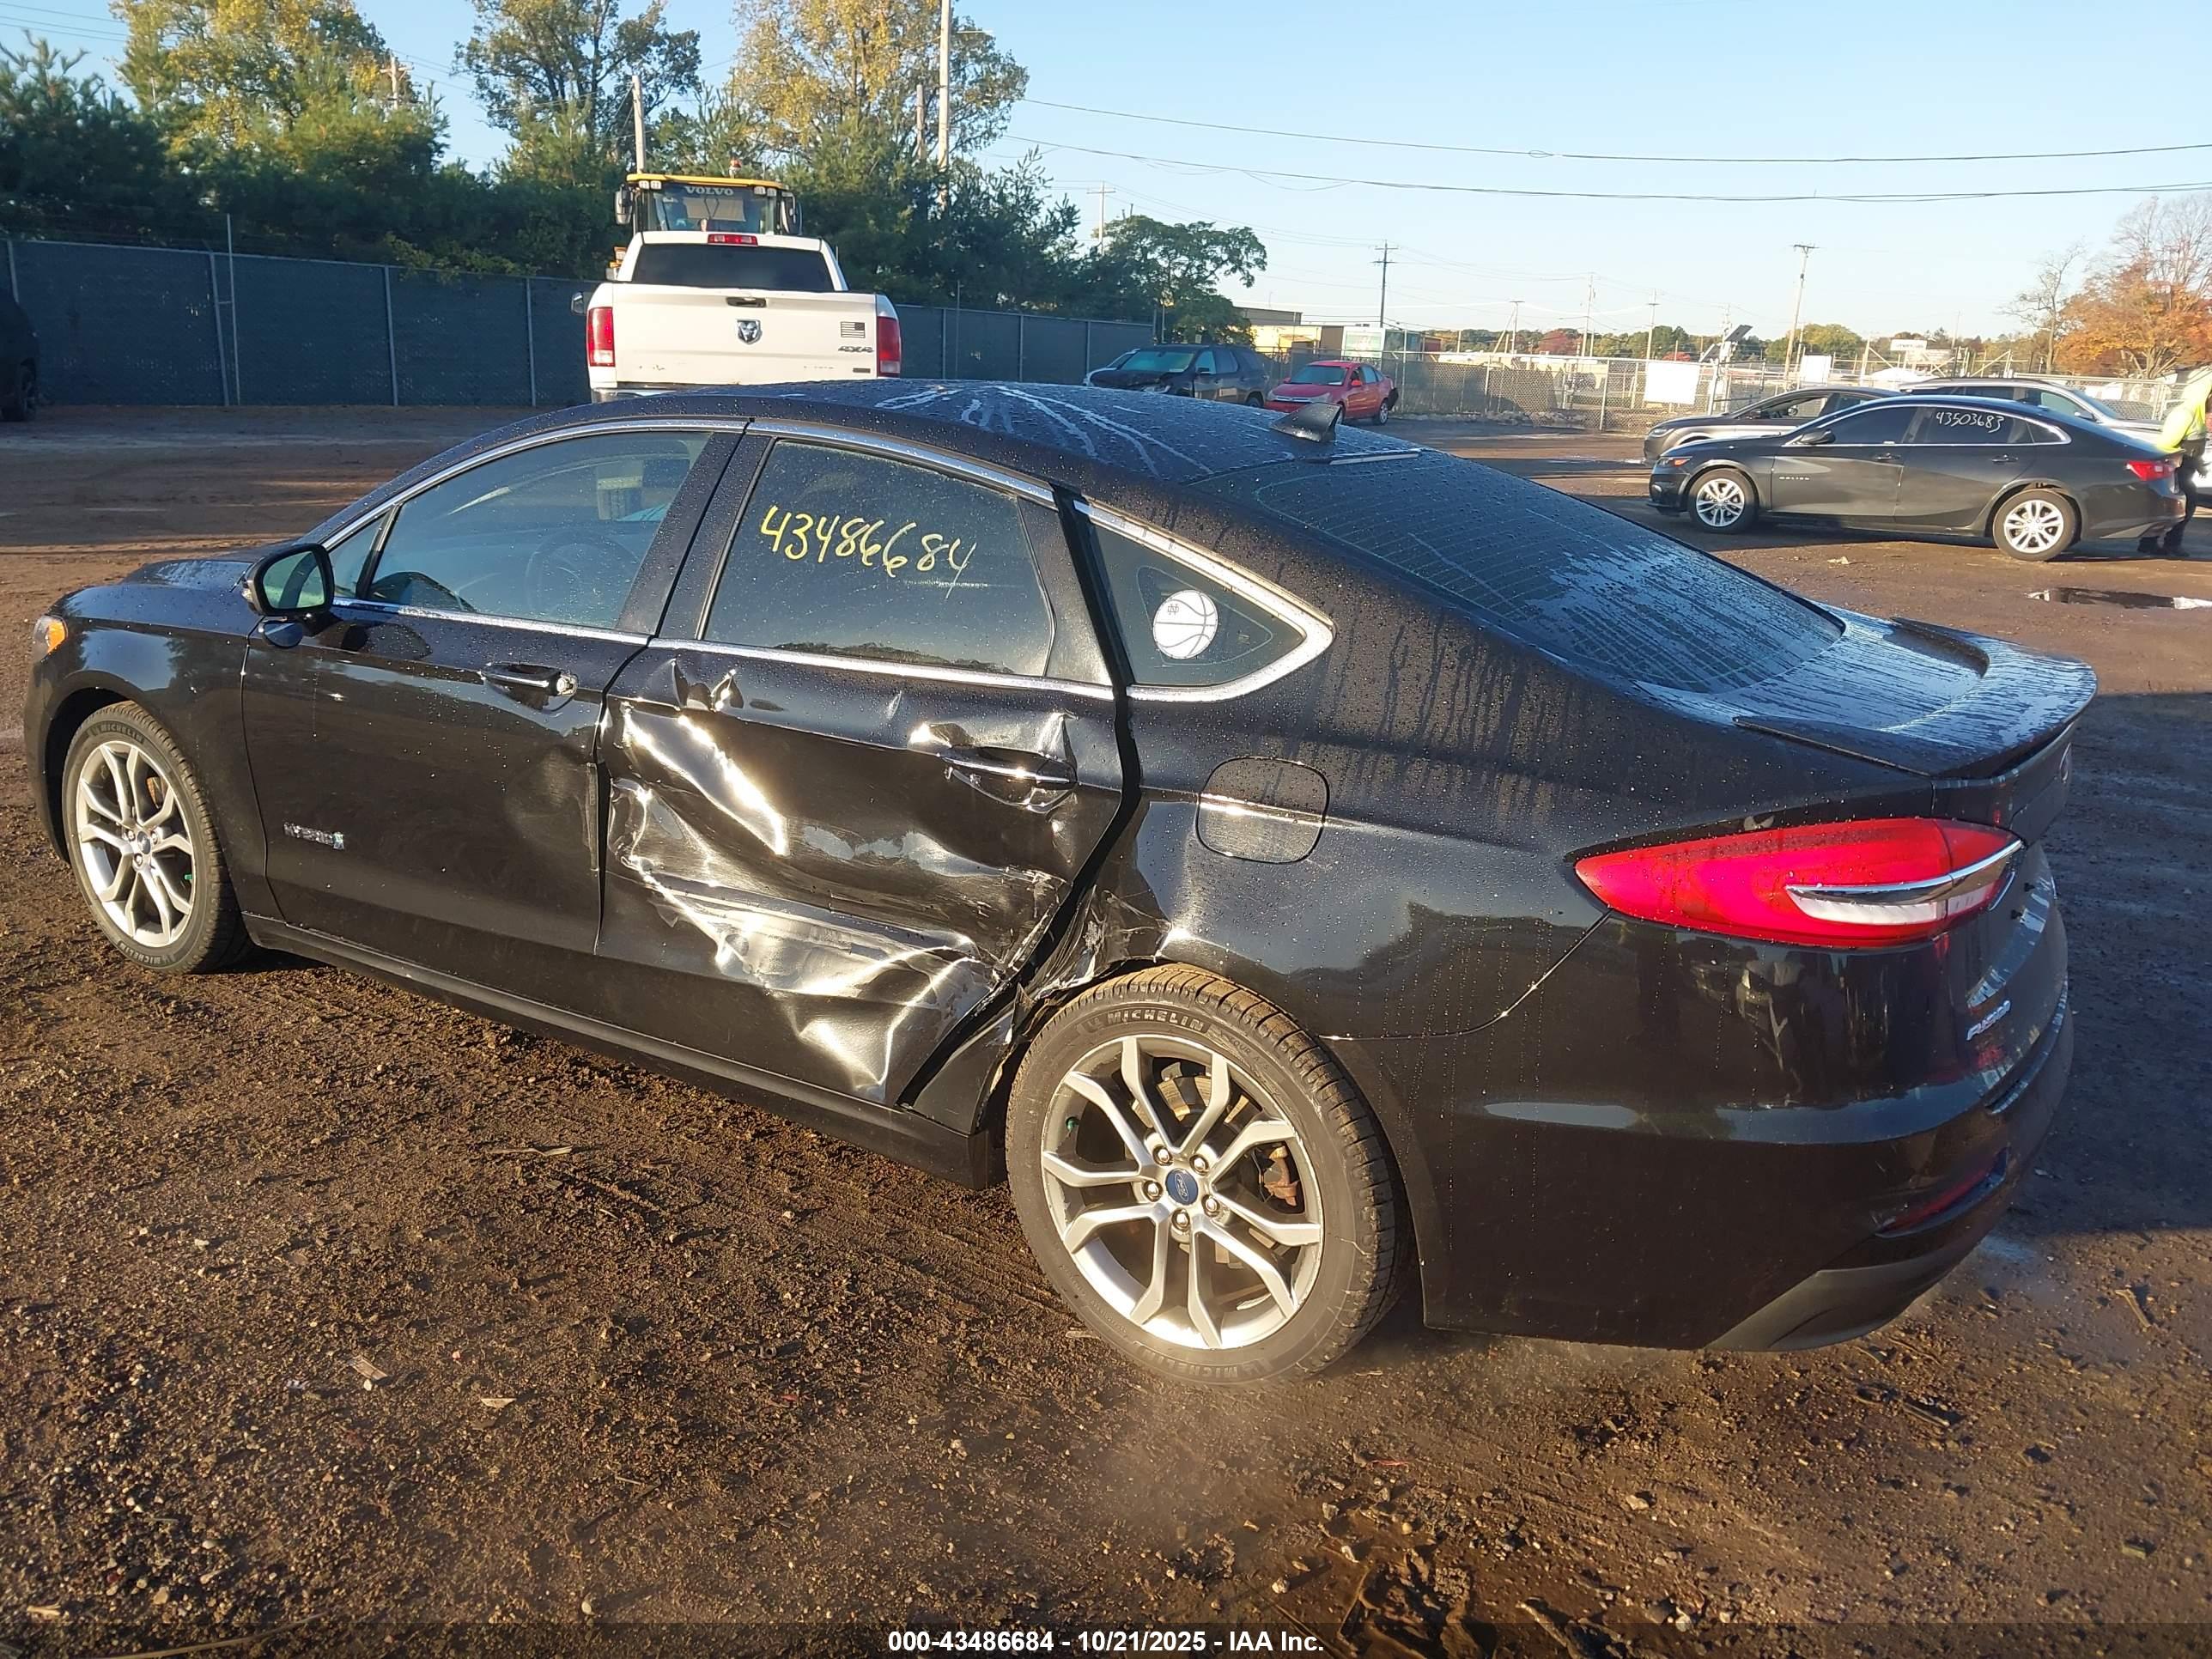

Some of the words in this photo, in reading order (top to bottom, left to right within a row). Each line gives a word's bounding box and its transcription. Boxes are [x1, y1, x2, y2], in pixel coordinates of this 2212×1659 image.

[684, 185, 734, 196] VOLVO
[1936, 411, 2005, 434] 43503683
[760, 505, 977, 599] 43486684
[1107, 1009, 1205, 1033] MICHELIN
